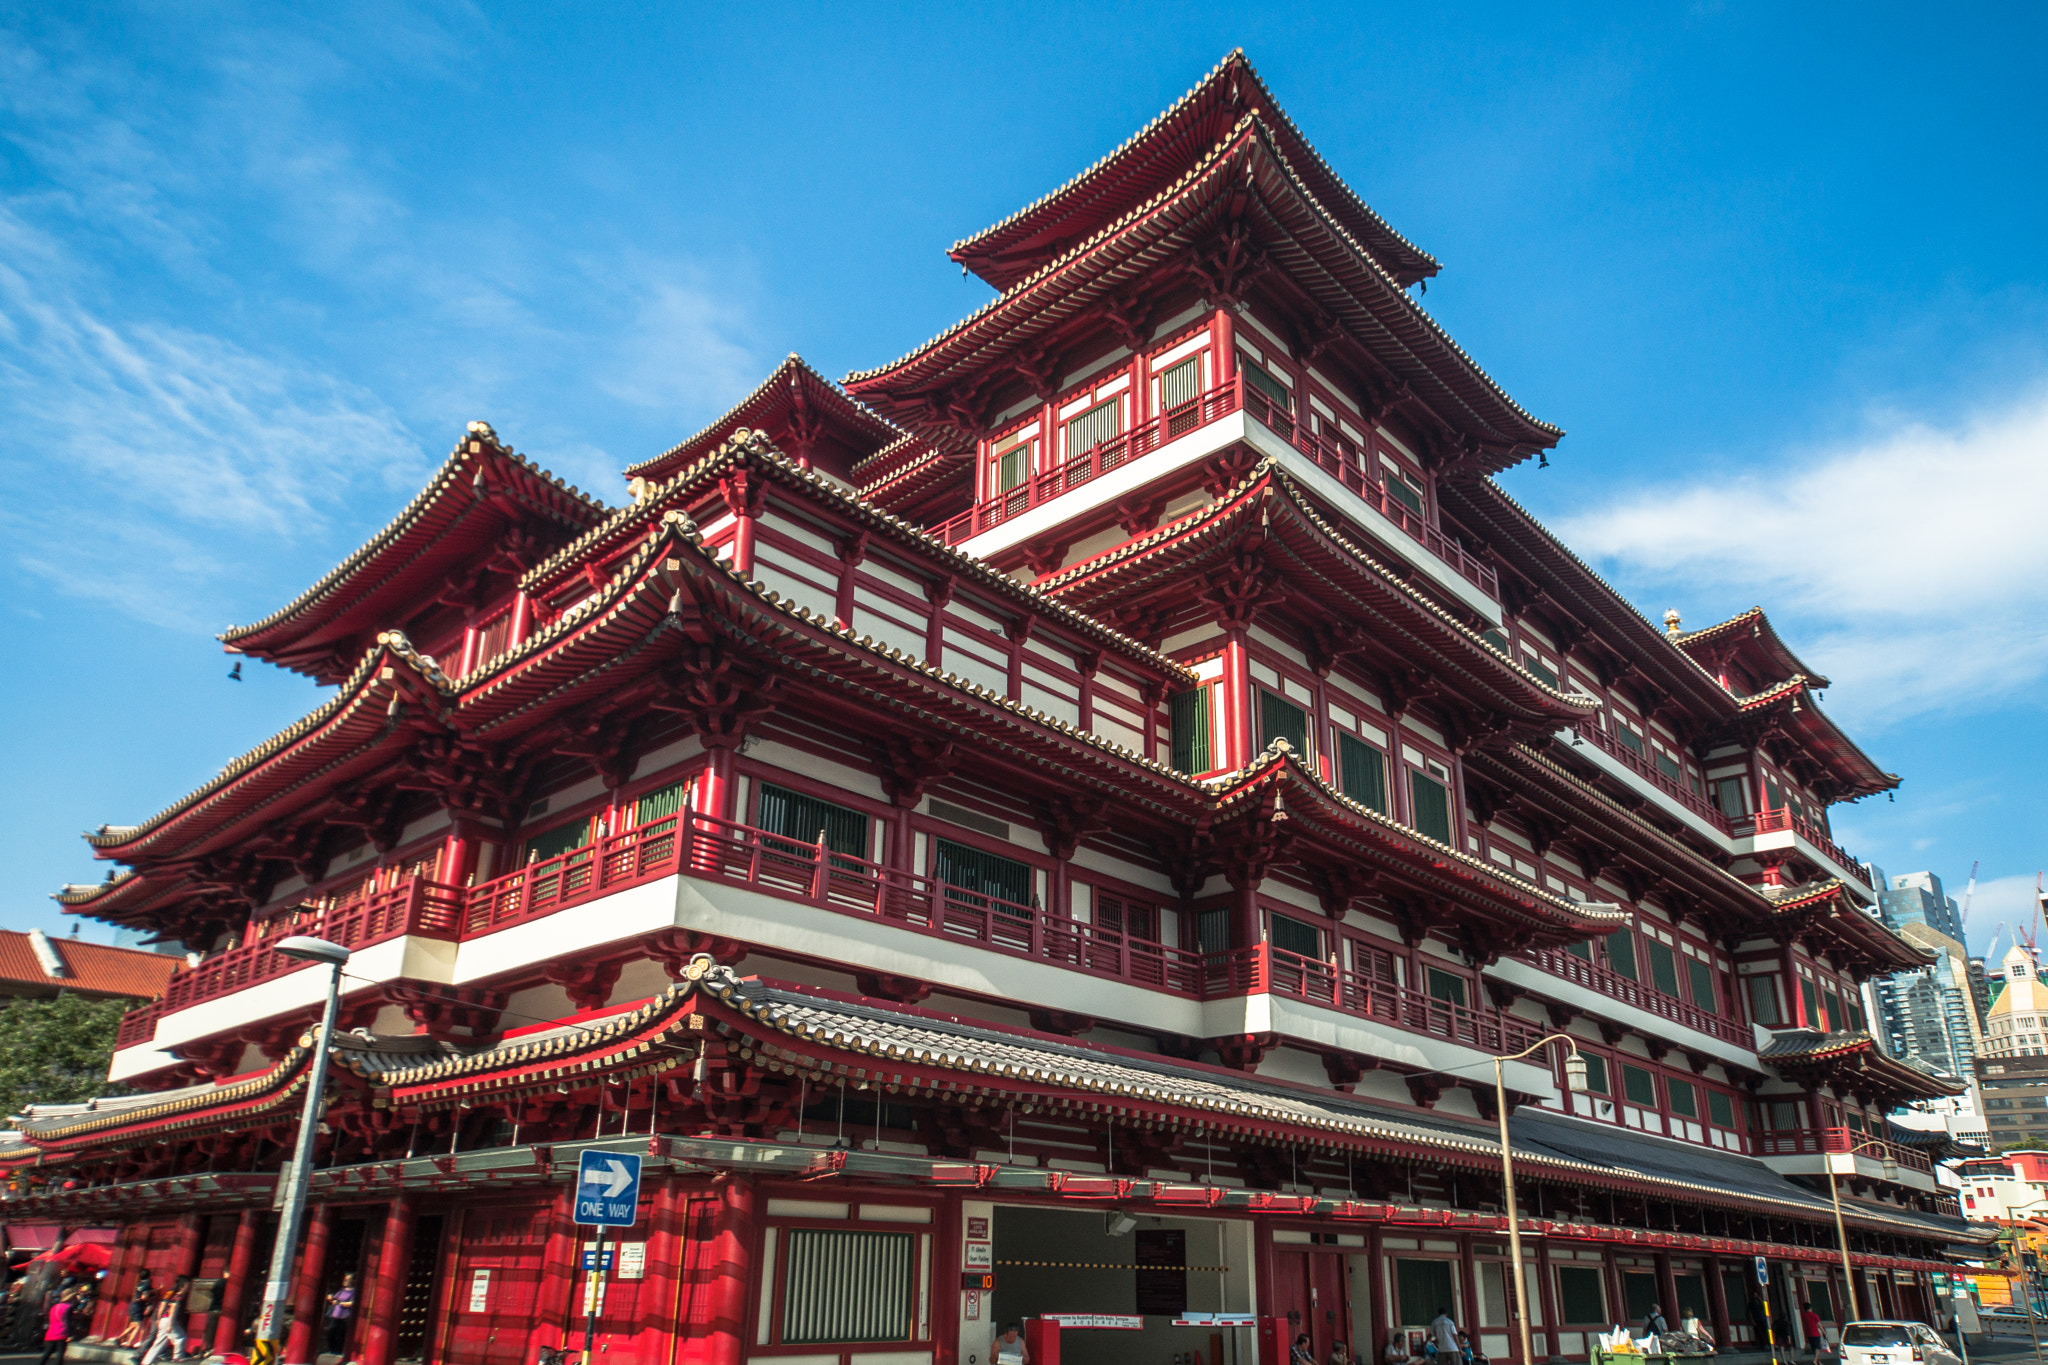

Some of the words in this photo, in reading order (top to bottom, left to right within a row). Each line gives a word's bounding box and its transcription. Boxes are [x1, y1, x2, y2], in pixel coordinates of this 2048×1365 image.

[580, 1201, 604, 1217] ONE
[608, 1203, 631, 1218] WAY
[982, 1275, 992, 1288] 10
